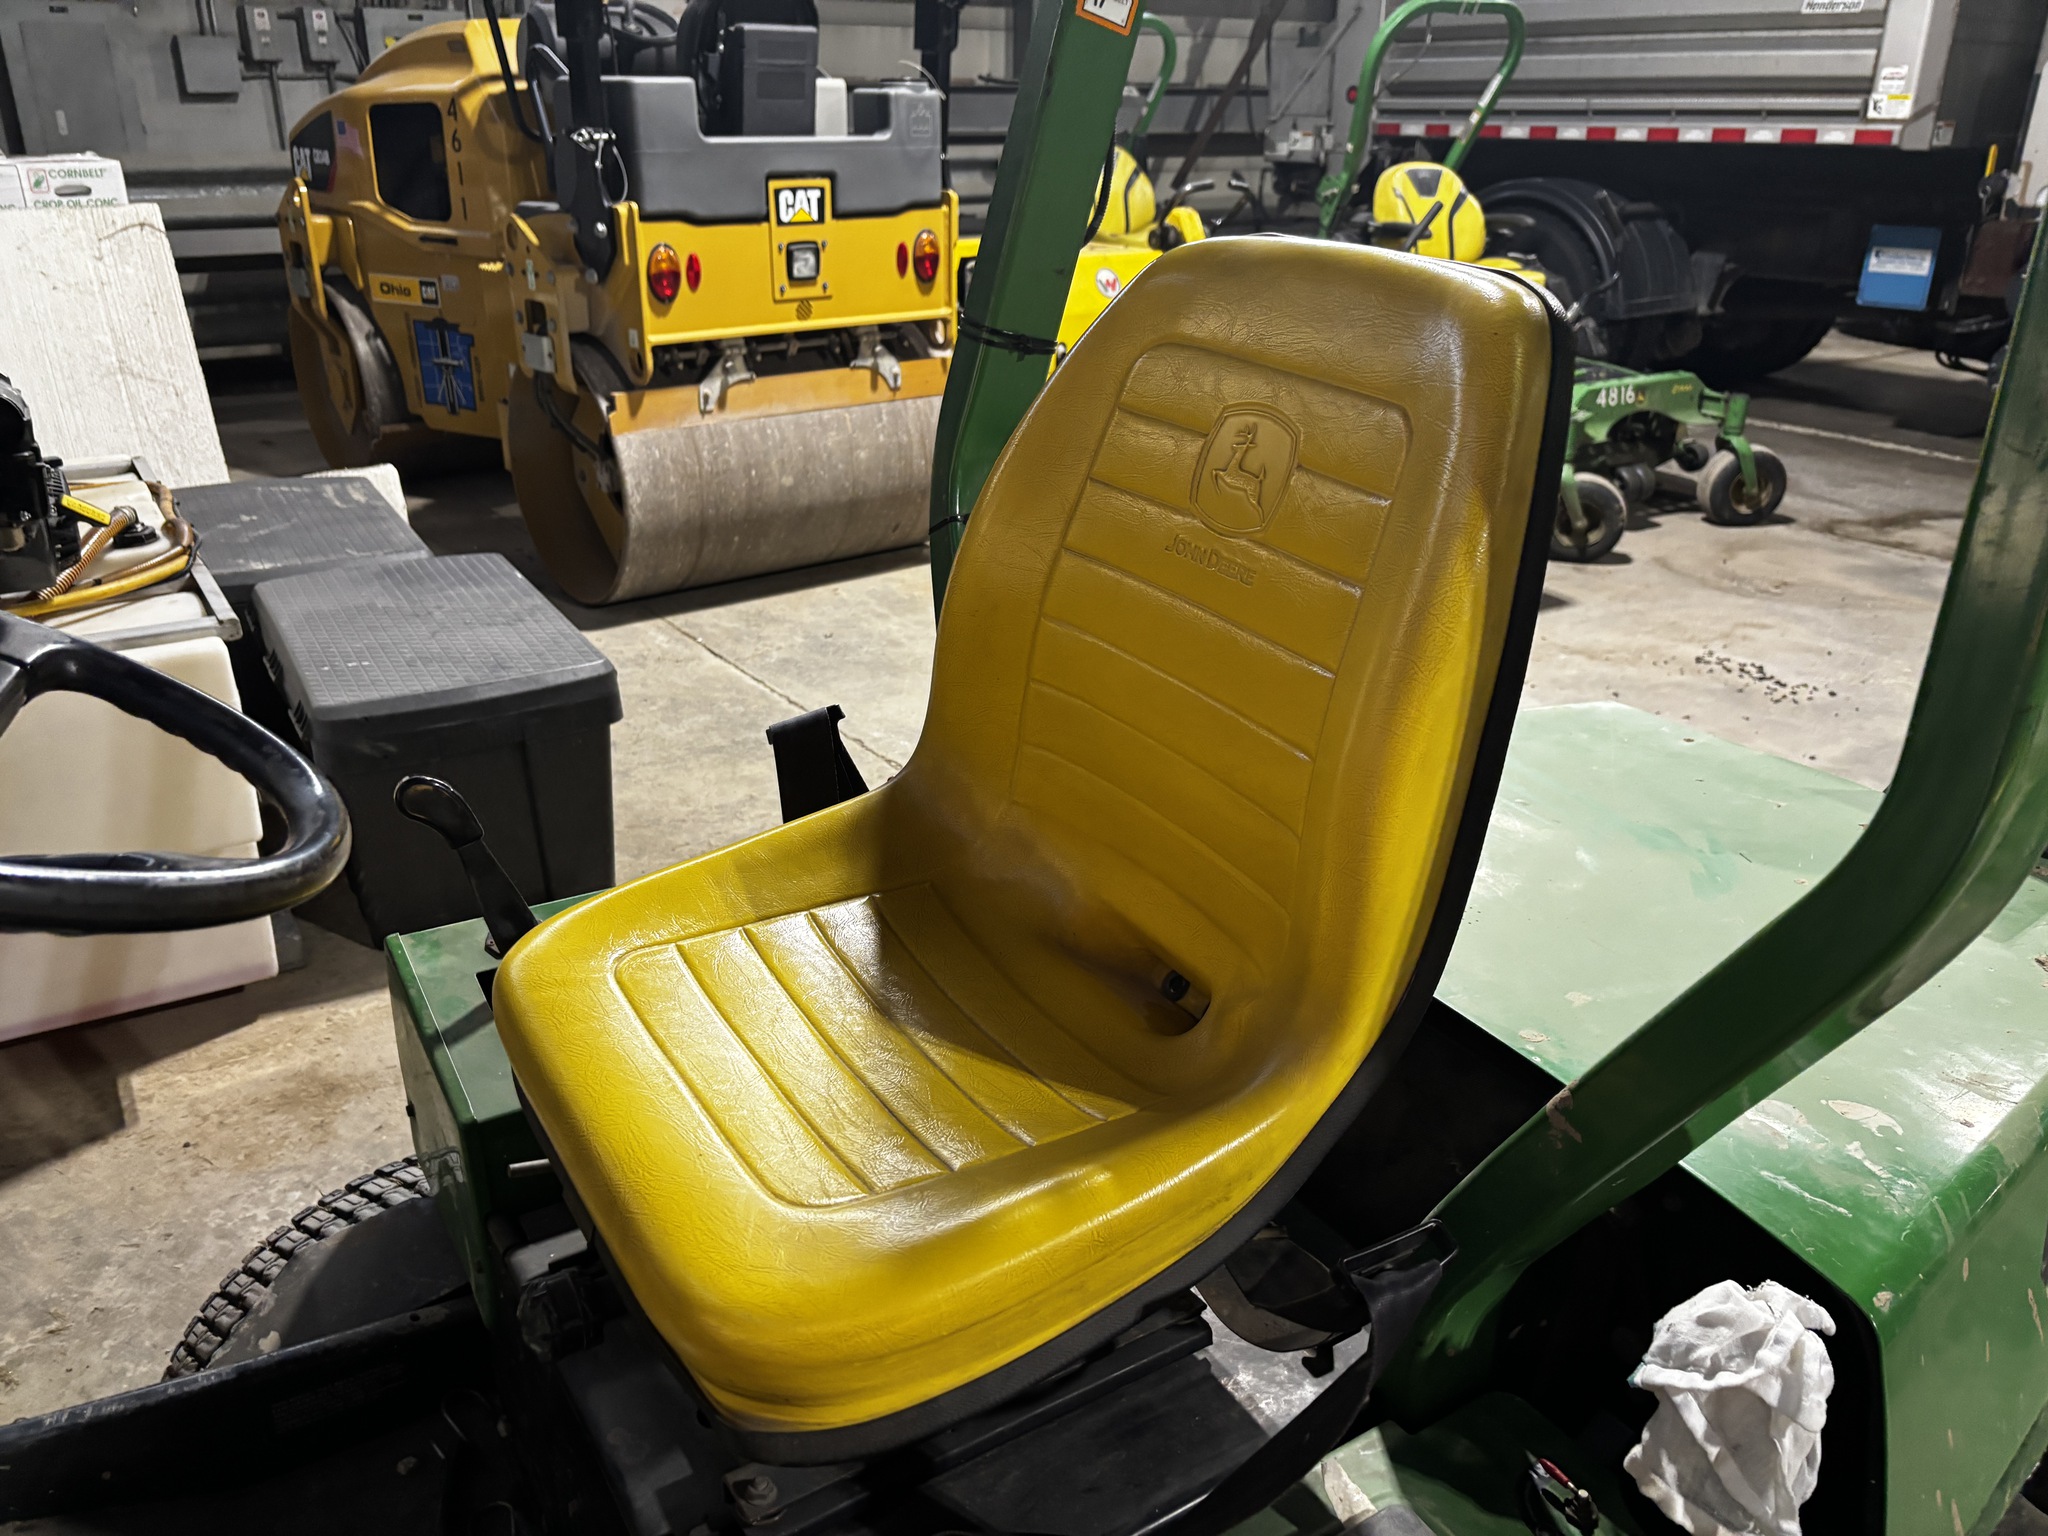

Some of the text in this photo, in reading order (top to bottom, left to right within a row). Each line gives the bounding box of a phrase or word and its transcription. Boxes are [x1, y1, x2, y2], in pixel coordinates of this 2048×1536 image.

[48, 168, 104, 179] CORNBELT
[292, 145, 313, 182] CAT
[33, 199, 63, 208] CROP
[778, 188, 821, 223] CAT
[380, 281, 412, 297] Ohio
[1596, 384, 1636, 408] 4816
[1205, 547, 1257, 588] DEERE
